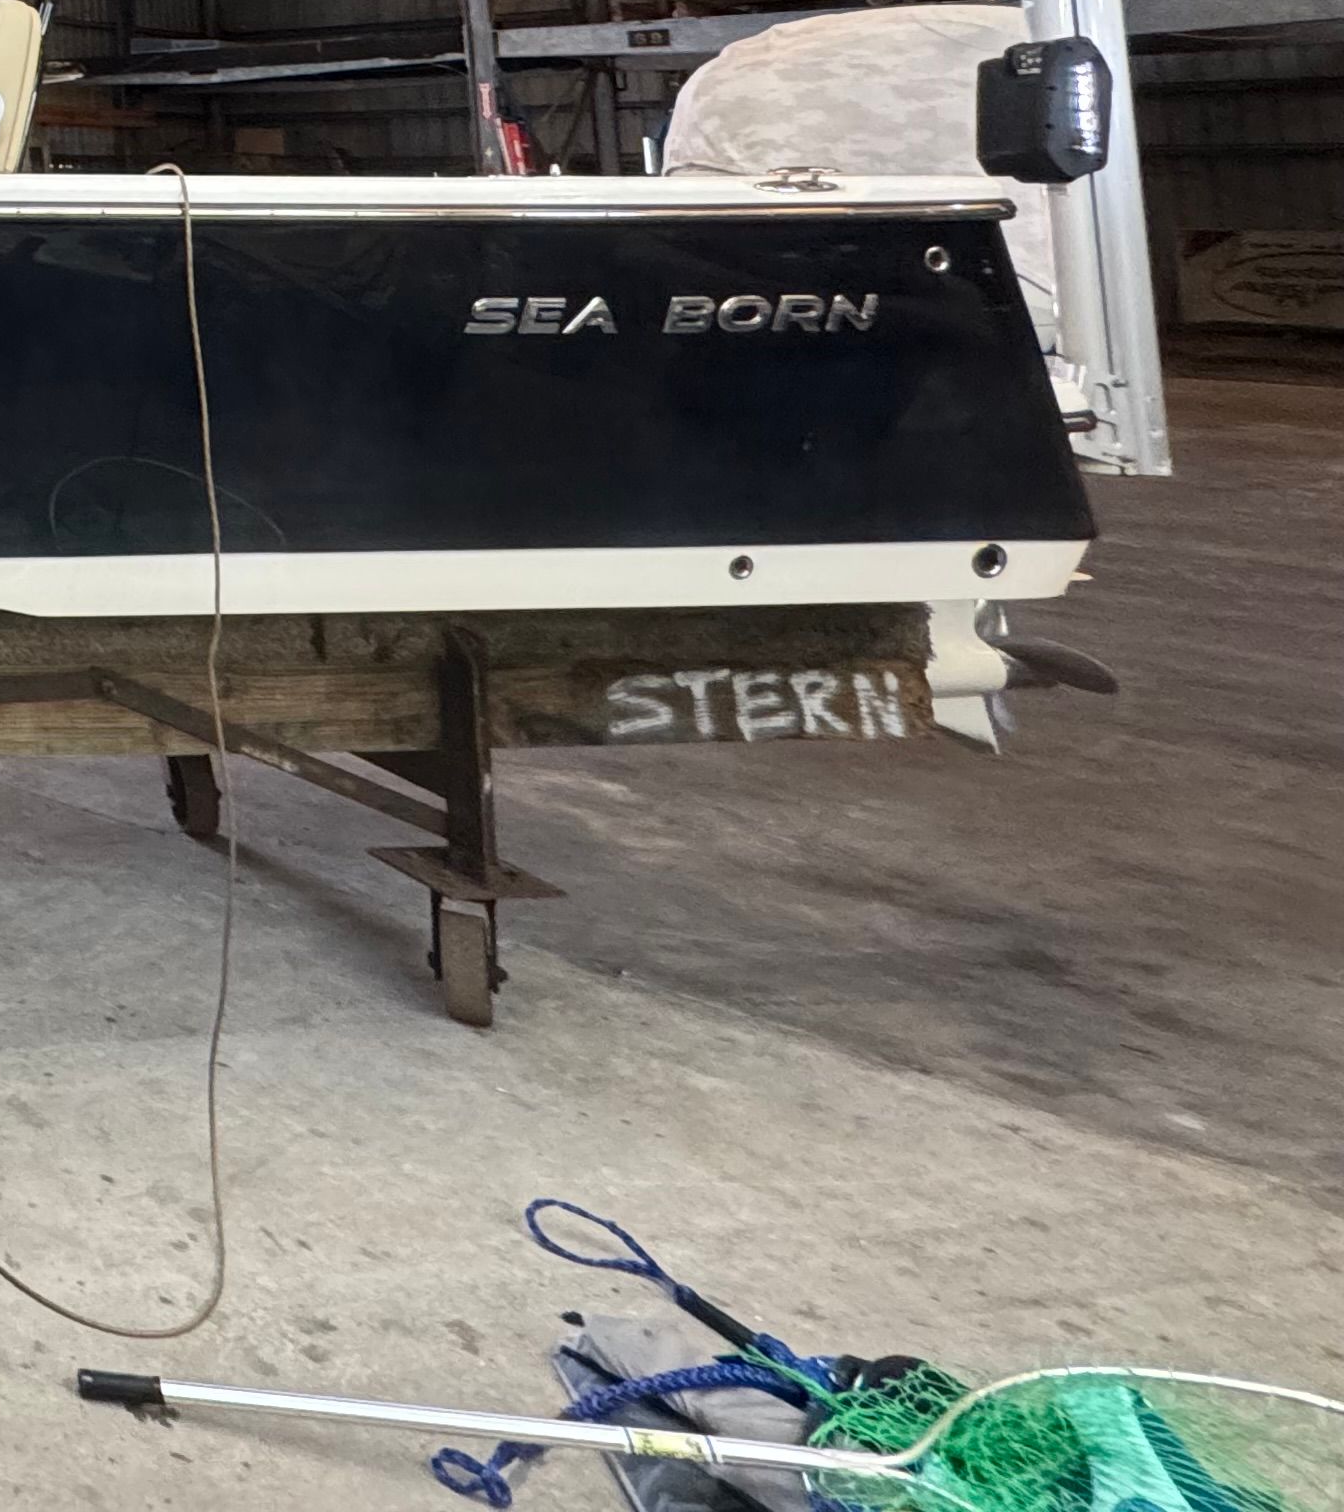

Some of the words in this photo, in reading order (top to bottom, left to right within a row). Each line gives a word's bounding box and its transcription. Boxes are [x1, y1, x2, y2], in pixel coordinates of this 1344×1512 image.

[463, 296, 620, 335] SEA
[662, 293, 880, 334] BORN
[607, 668, 907, 742] STERN
